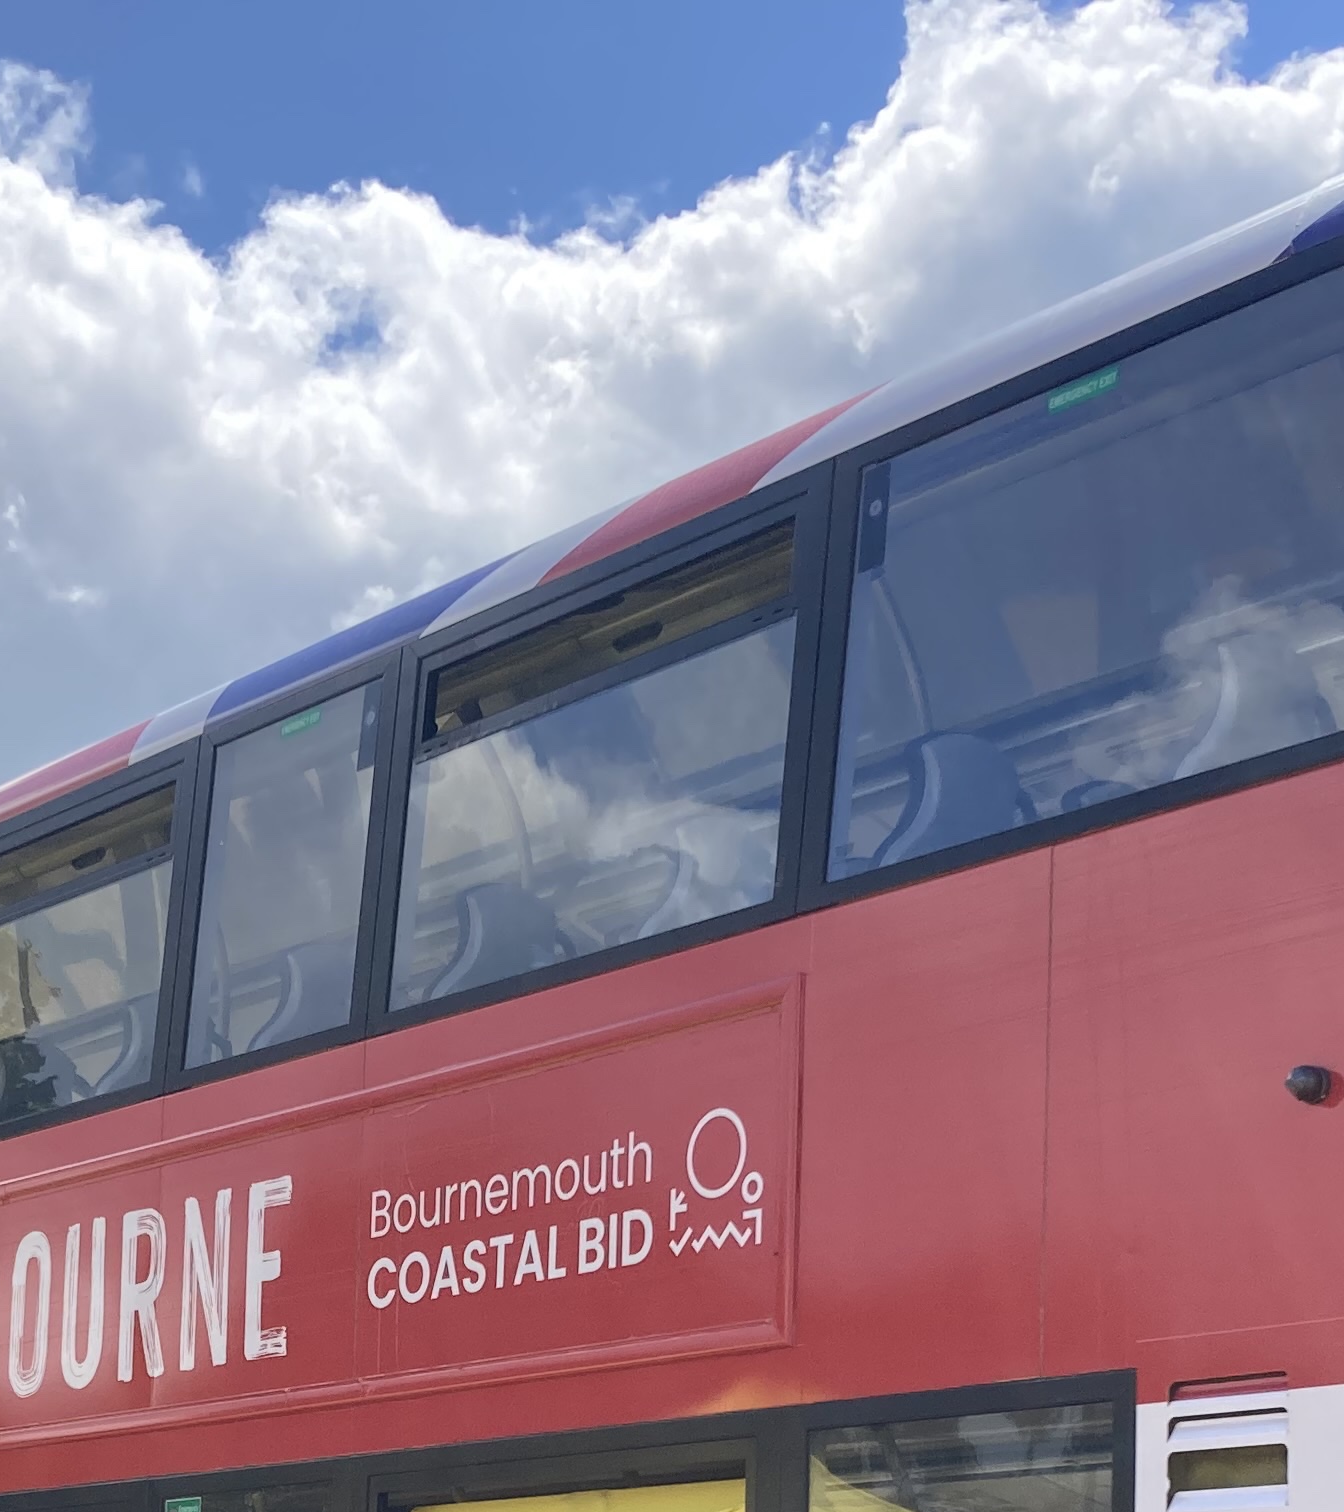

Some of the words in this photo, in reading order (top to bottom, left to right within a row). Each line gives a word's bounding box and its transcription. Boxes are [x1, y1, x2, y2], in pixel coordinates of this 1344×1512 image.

[369, 1131, 654, 1239] Bournemouth
[367, 1225, 567, 1309] COASTAL
[577, 1208, 654, 1276] BID
